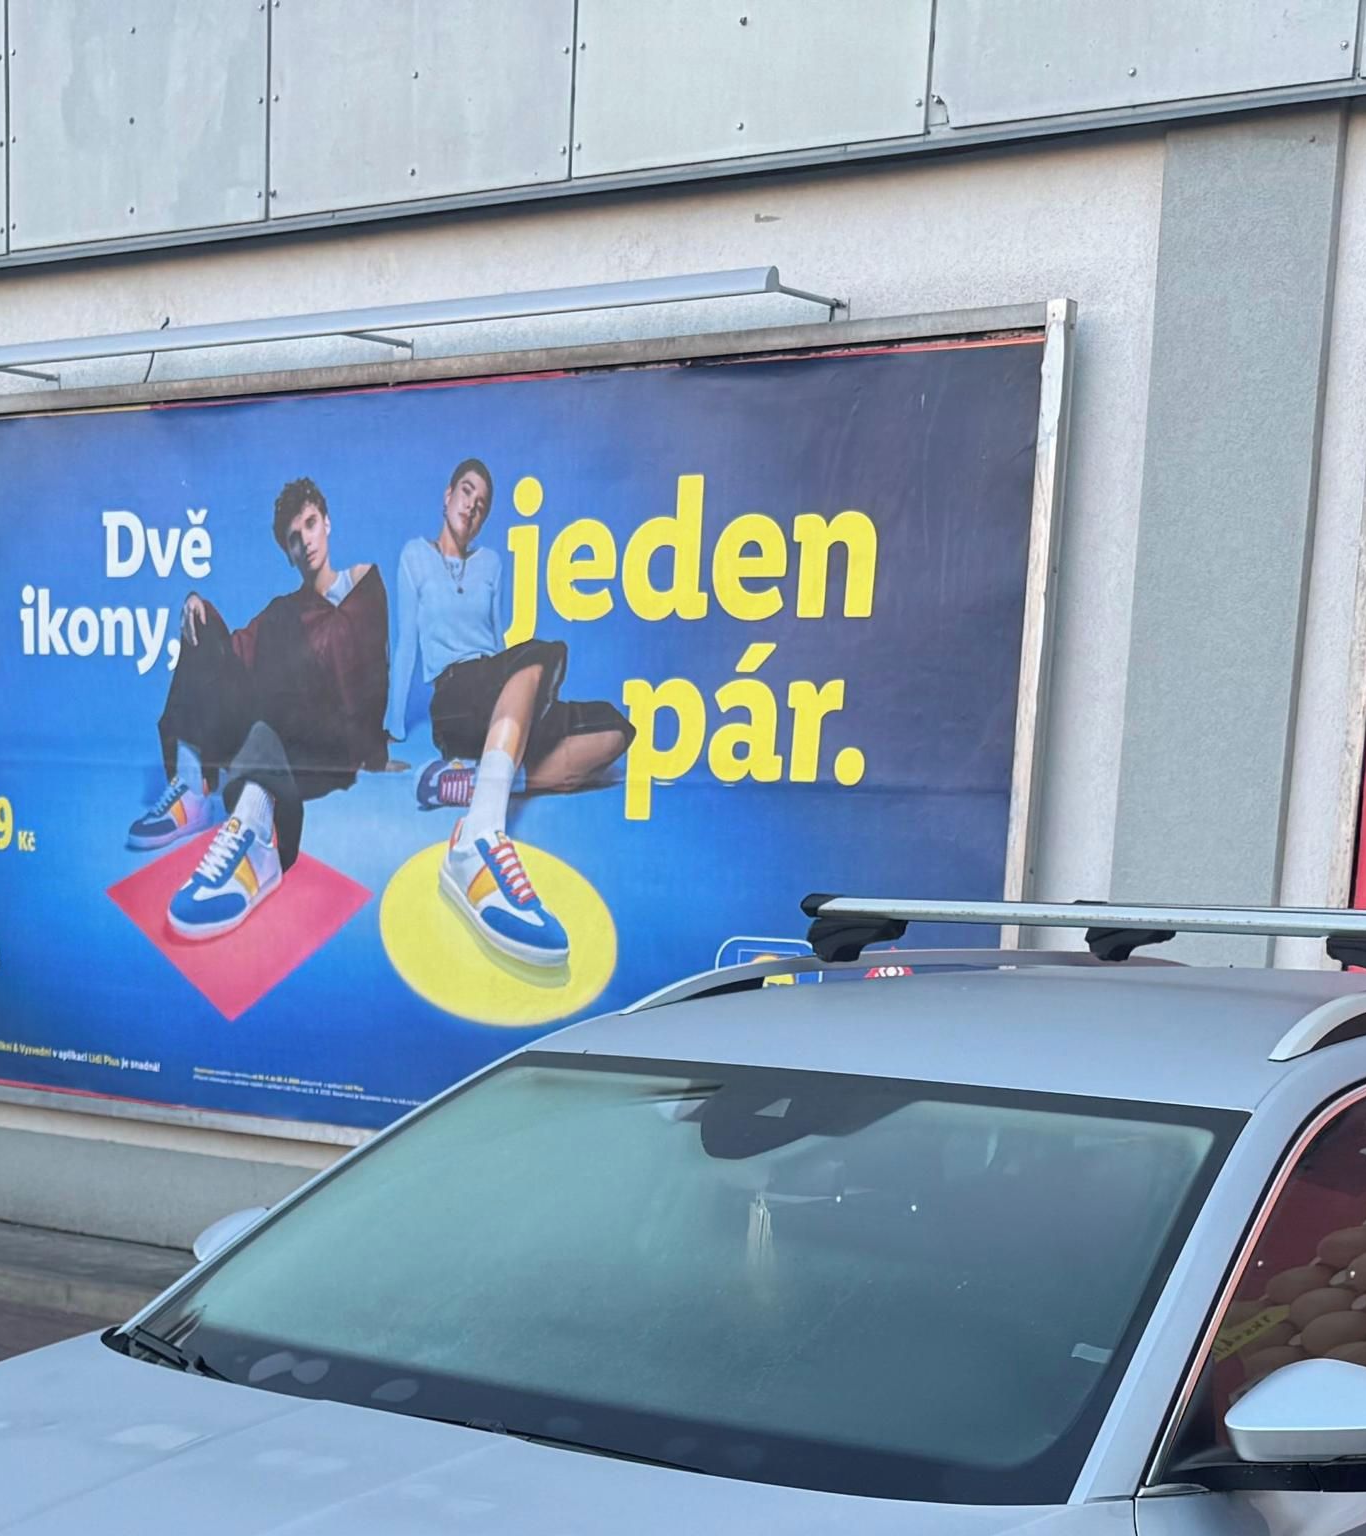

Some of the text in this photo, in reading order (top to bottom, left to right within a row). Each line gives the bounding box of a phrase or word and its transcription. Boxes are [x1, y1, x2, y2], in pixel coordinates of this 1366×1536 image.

[102, 508, 212, 579] Dvě
[505, 474, 878, 649] jeden
[20, 584, 181, 676] ikony,
[622, 642, 866, 820] pár.
[18, 831, 36, 852] Kč
